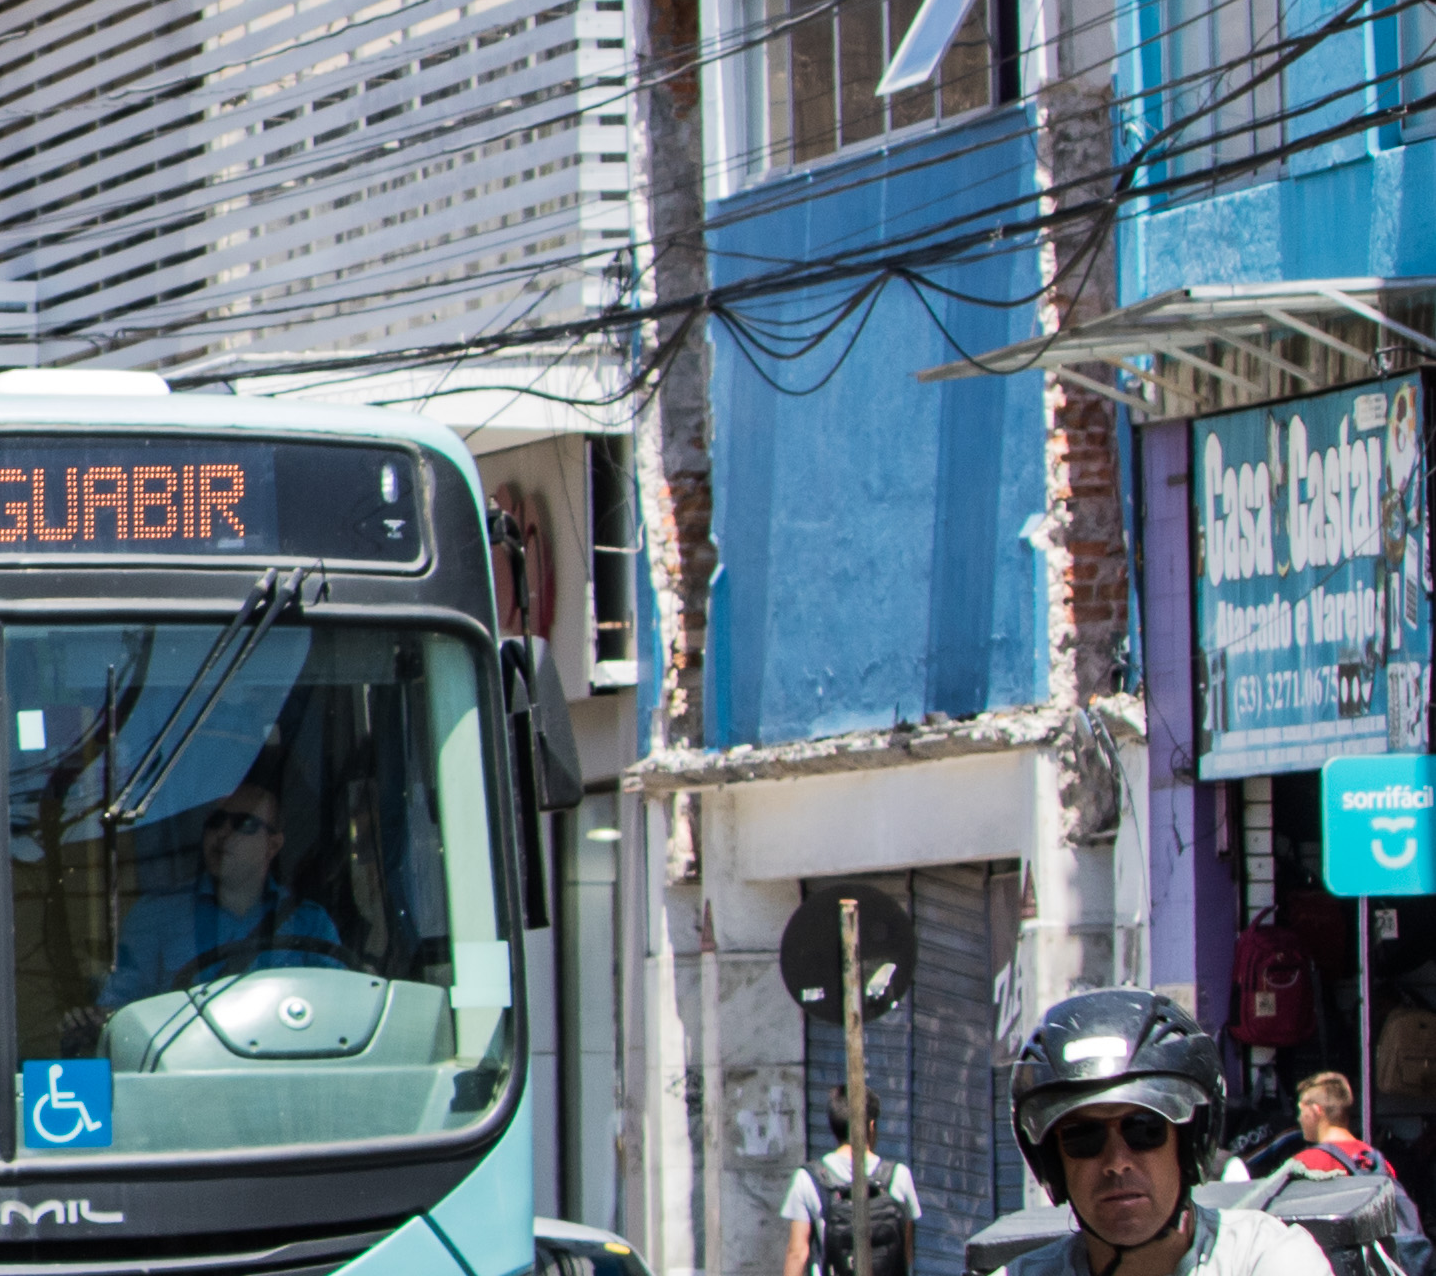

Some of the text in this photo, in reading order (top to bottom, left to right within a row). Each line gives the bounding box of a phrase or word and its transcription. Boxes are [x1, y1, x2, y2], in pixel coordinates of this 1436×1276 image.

[1205, 414, 1381, 587] Casa Castar
[1216, 579, 1375, 655] Atacado e Varejo
[1234, 676, 1263, 722] (53)
[1342, 786, 1434, 810] sorrifácil
